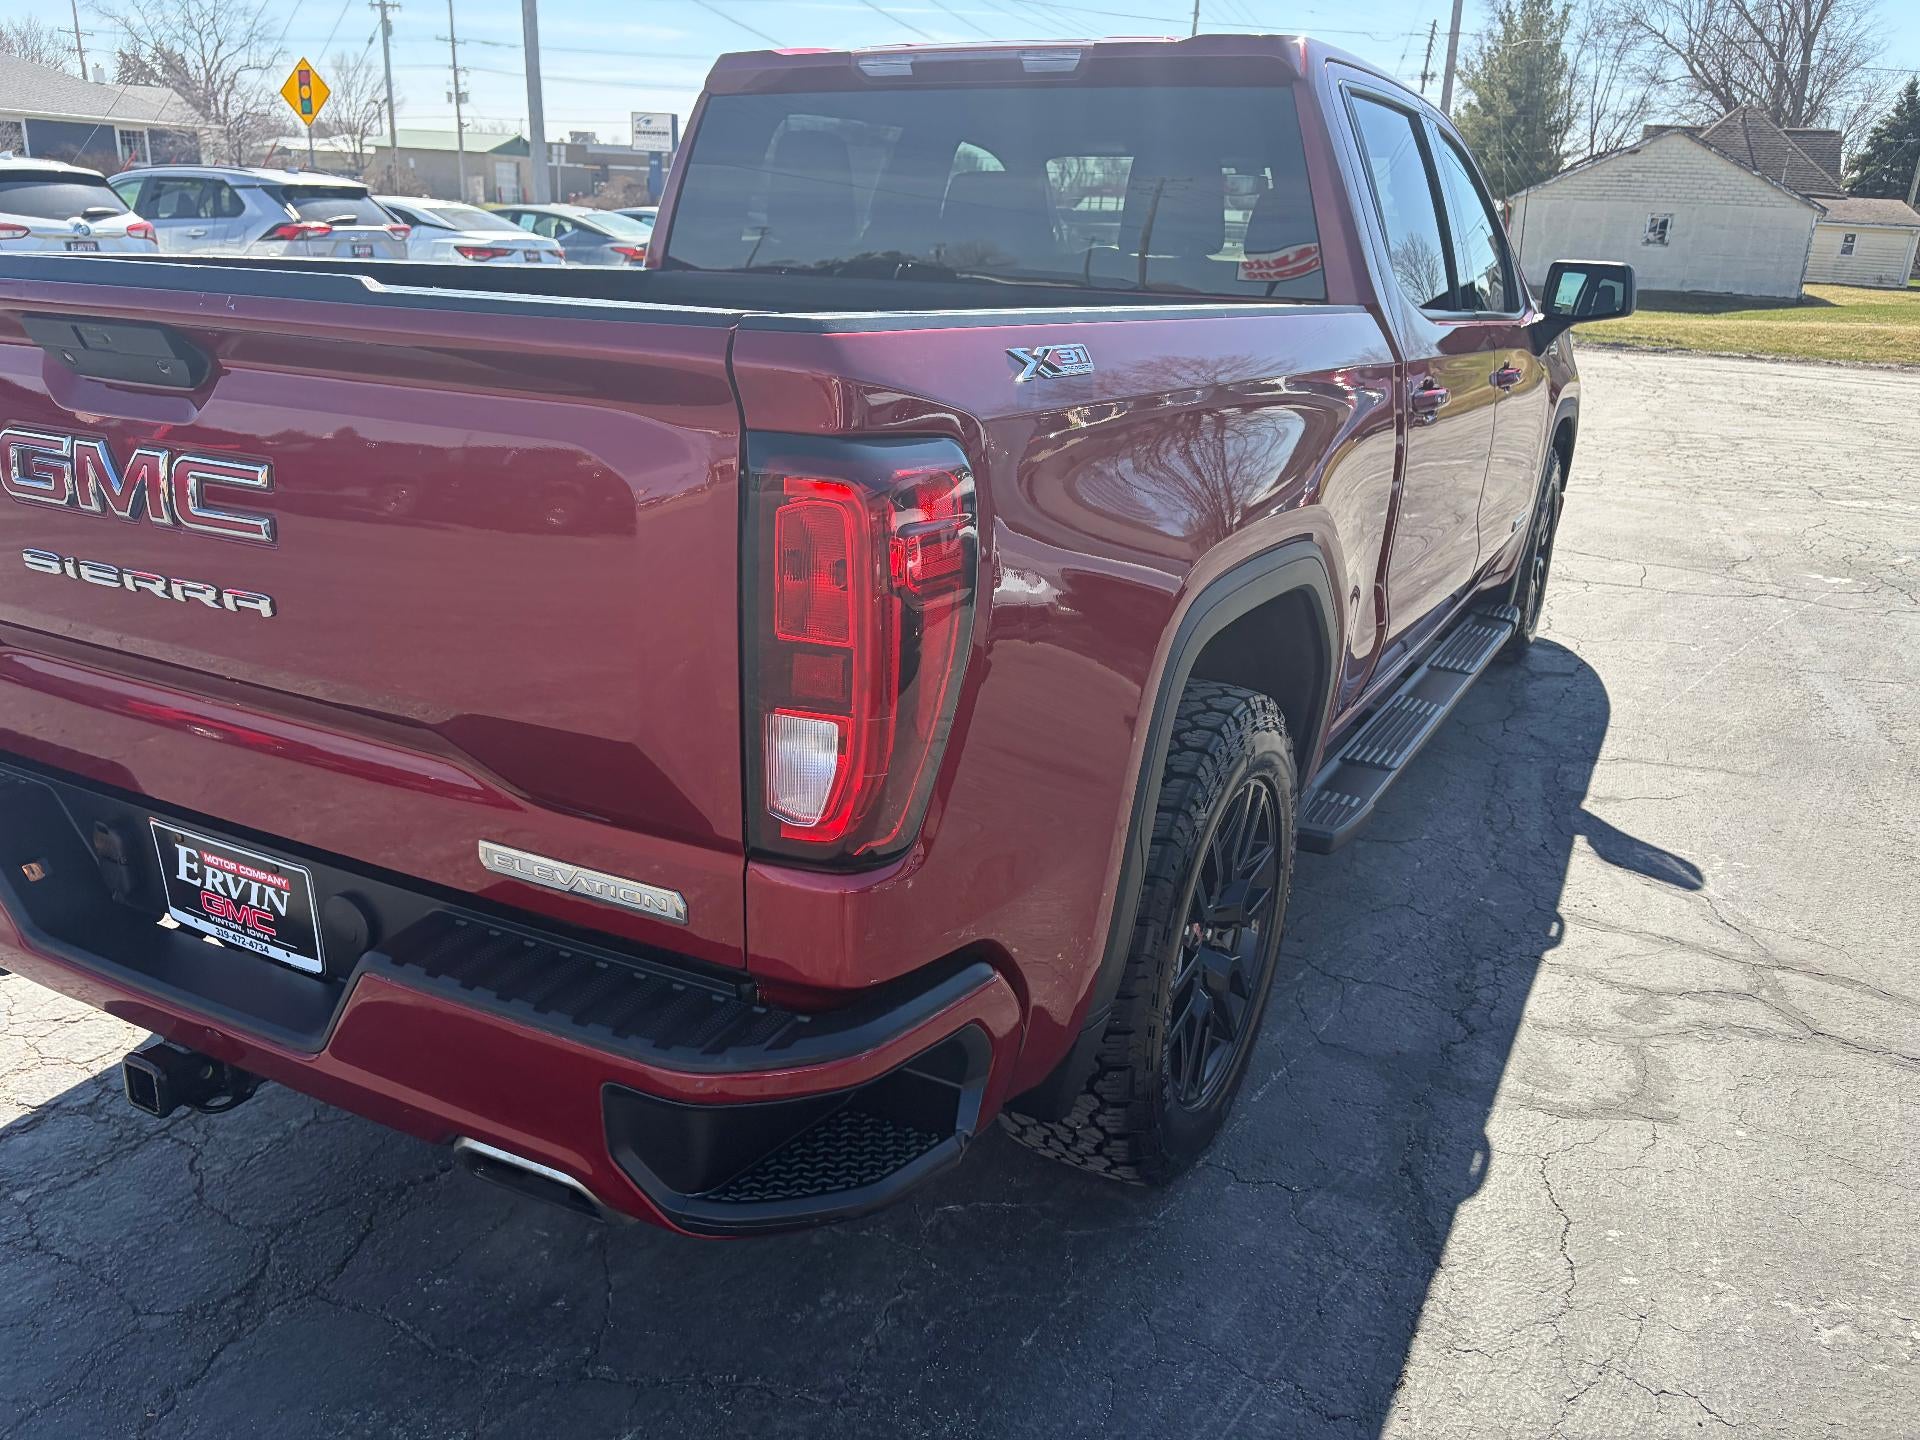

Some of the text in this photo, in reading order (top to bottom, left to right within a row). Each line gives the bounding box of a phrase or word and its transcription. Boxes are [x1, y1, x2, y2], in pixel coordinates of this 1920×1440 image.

[1005, 344, 1095, 382] X31
[0, 426, 275, 544] GMC
[22, 548, 277, 618] SIERRA
[174, 843, 291, 917] ERVIN
[203, 853, 287, 888] MOTOR COMPANY
[493, 852, 668, 913] ELEVATION
[200, 890, 277, 936] GMC
[209, 914, 271, 942] VINTON, IOWA
[215, 927, 270, 954] 319-472-4734
